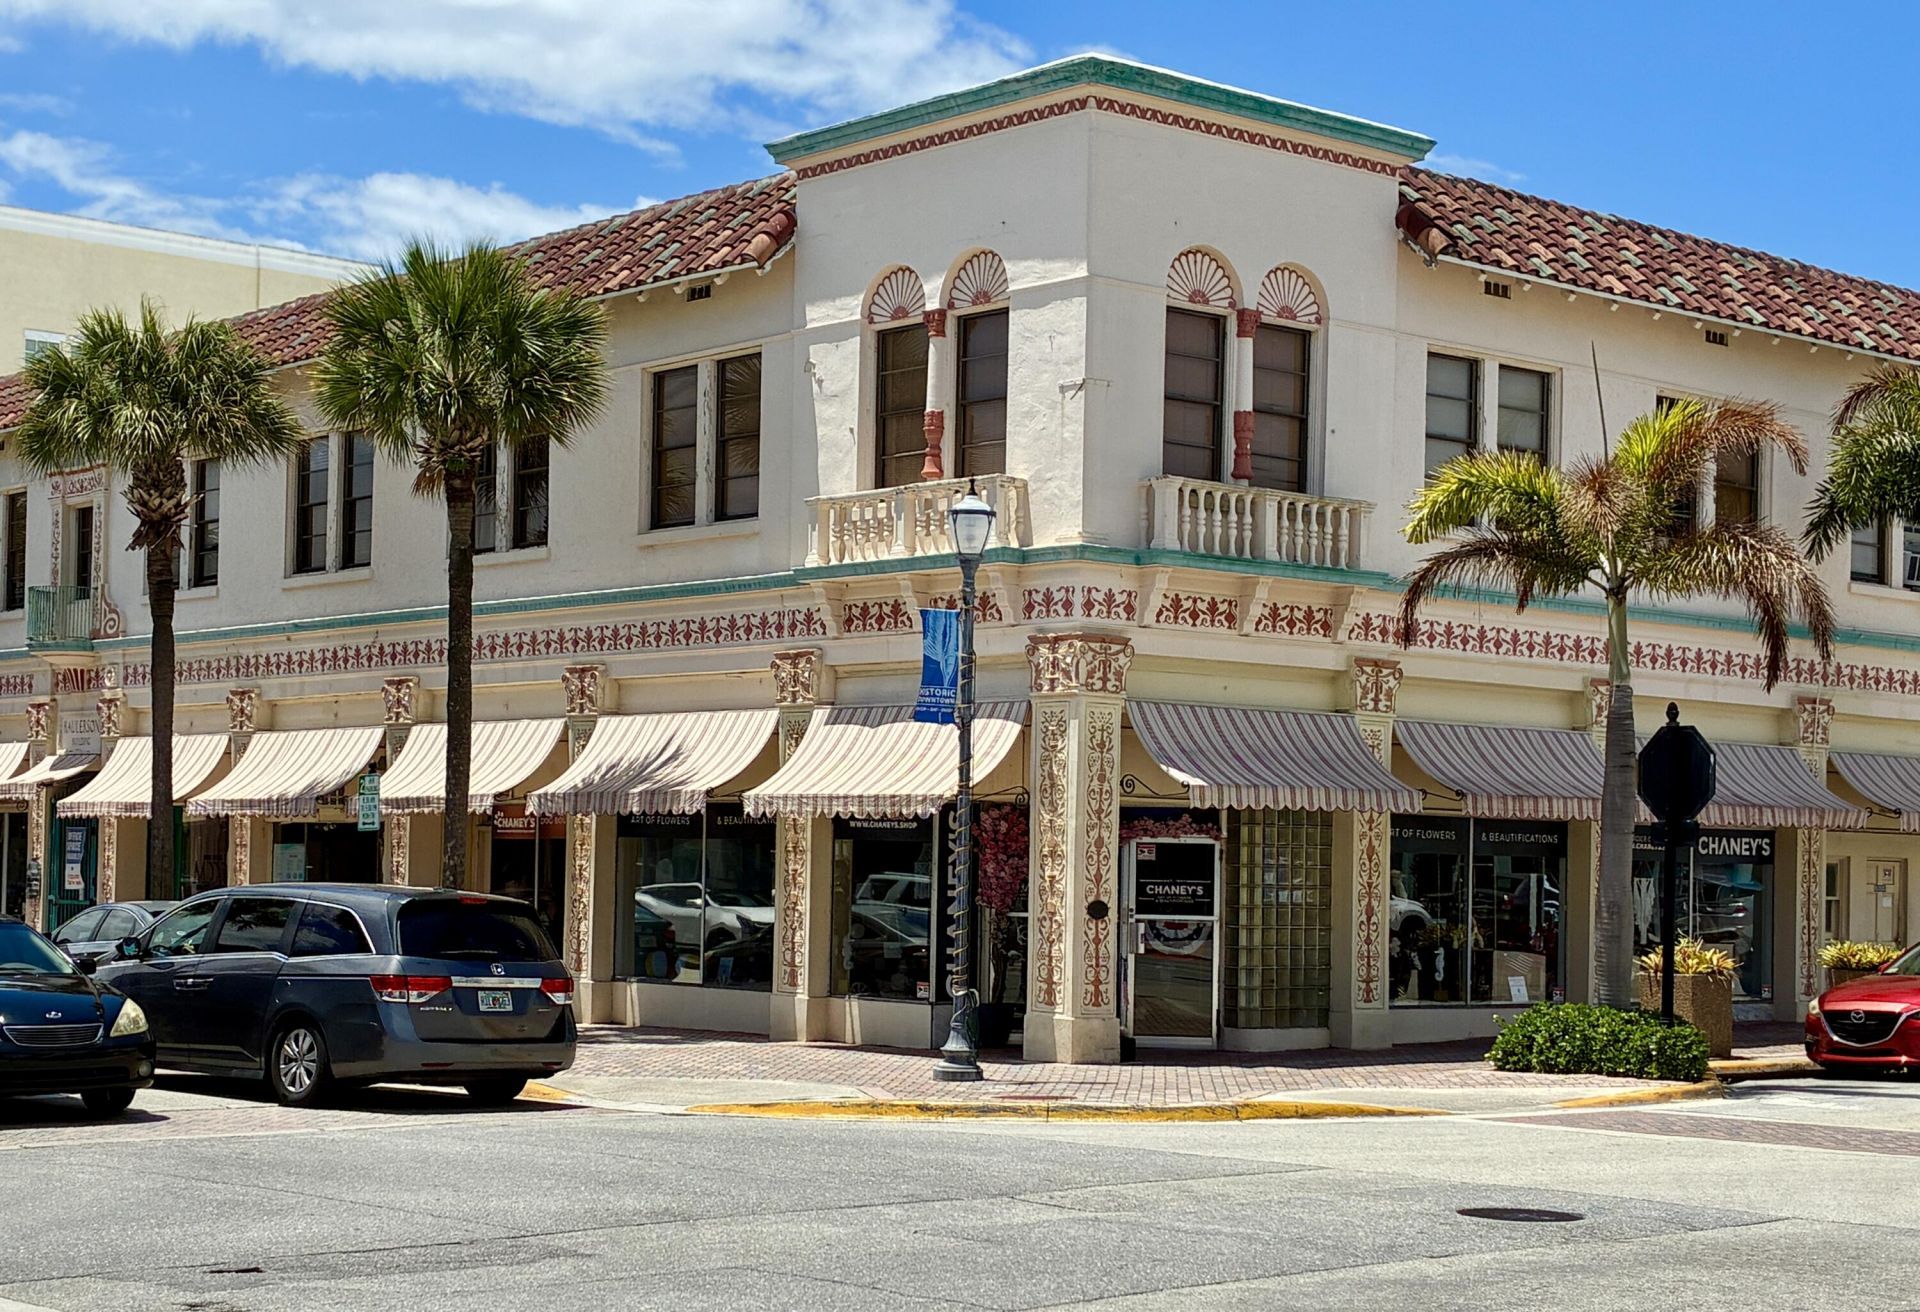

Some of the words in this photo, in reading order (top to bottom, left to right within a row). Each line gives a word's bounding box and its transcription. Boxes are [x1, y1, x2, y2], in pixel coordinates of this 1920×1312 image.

[919, 688, 957, 697] HISTORIC
[917, 696, 956, 704] DOWNTOWN
[497, 817, 536, 828] CHANEY'S
[630, 816, 644, 824] ART
[645, 816, 656, 825] OF
[656, 816, 691, 825] FLOWERS
[724, 816, 777, 825] BEAUTIFICATIO
[849, 820, 918, 829] WWW.CHANEYS.SHOP
[1401, 828, 1413, 838] OF
[1416, 829, 1456, 841] FLOWERS
[1481, 832, 1487, 841] &
[1489, 832, 1558, 844] BEAUTIFICATIONS
[1698, 836, 1771, 856] CHANEY'S
[1145, 884, 1204, 895] CHANEY'S
